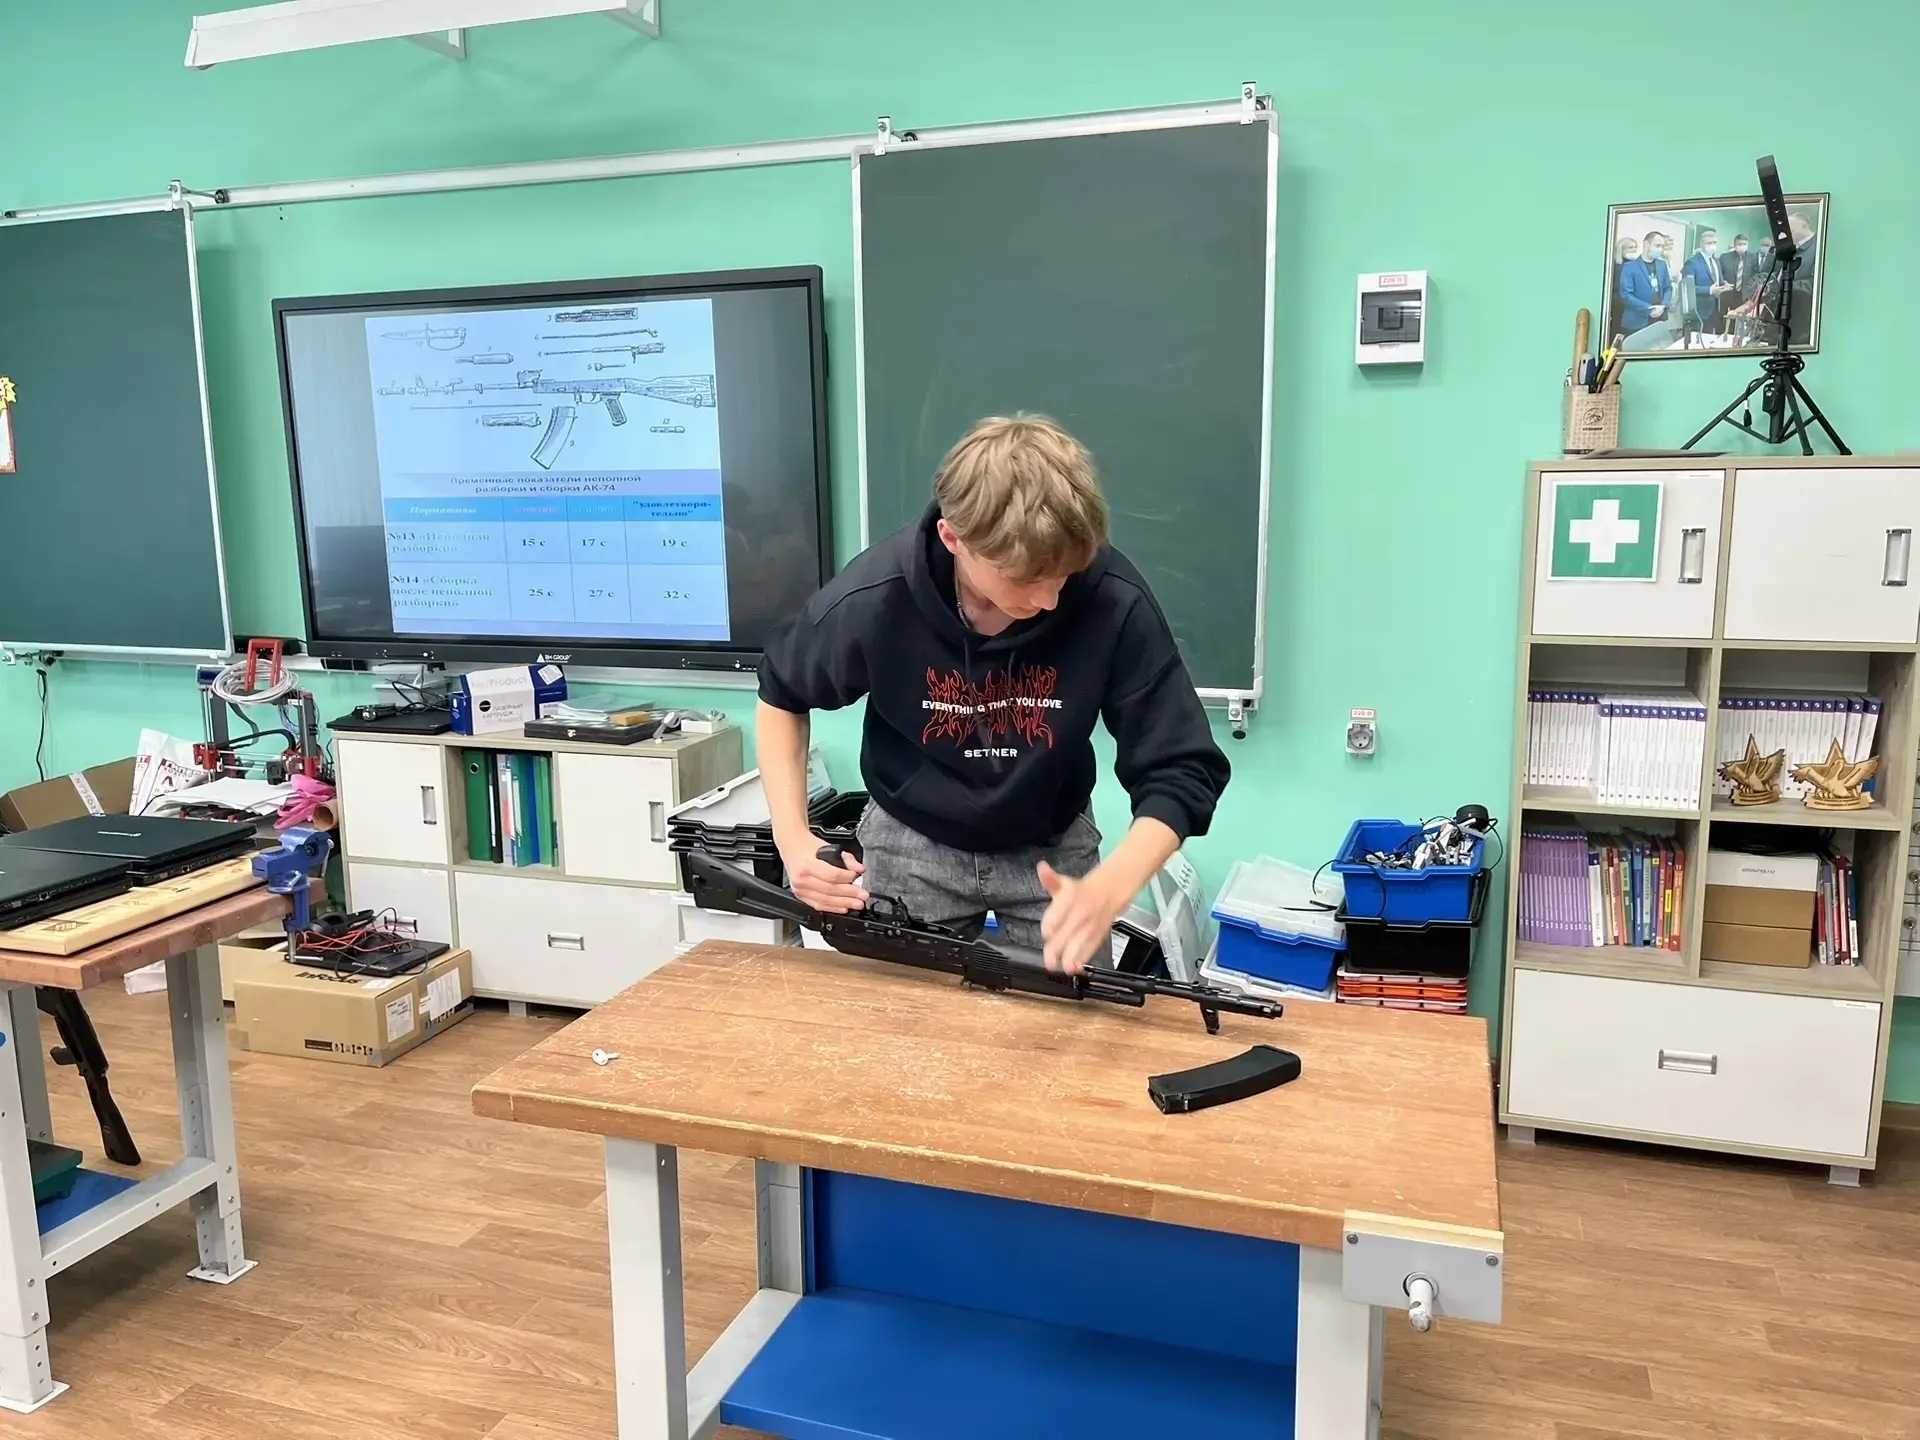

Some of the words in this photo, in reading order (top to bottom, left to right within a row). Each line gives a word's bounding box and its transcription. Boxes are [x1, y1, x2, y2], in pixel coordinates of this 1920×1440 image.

[582, 484, 616, 492] АК-74
[522, 538, 536, 547] 15
[582, 538, 596, 547] 17
[661, 539, 676, 548] 19
[529, 588, 544, 597] 25
[589, 589, 604, 598] 27
[663, 590, 680, 599] 32
[1016, 697, 1035, 707] YOU
[1037, 699, 1063, 709] LOVE
[964, 748, 1018, 758] SETNER
